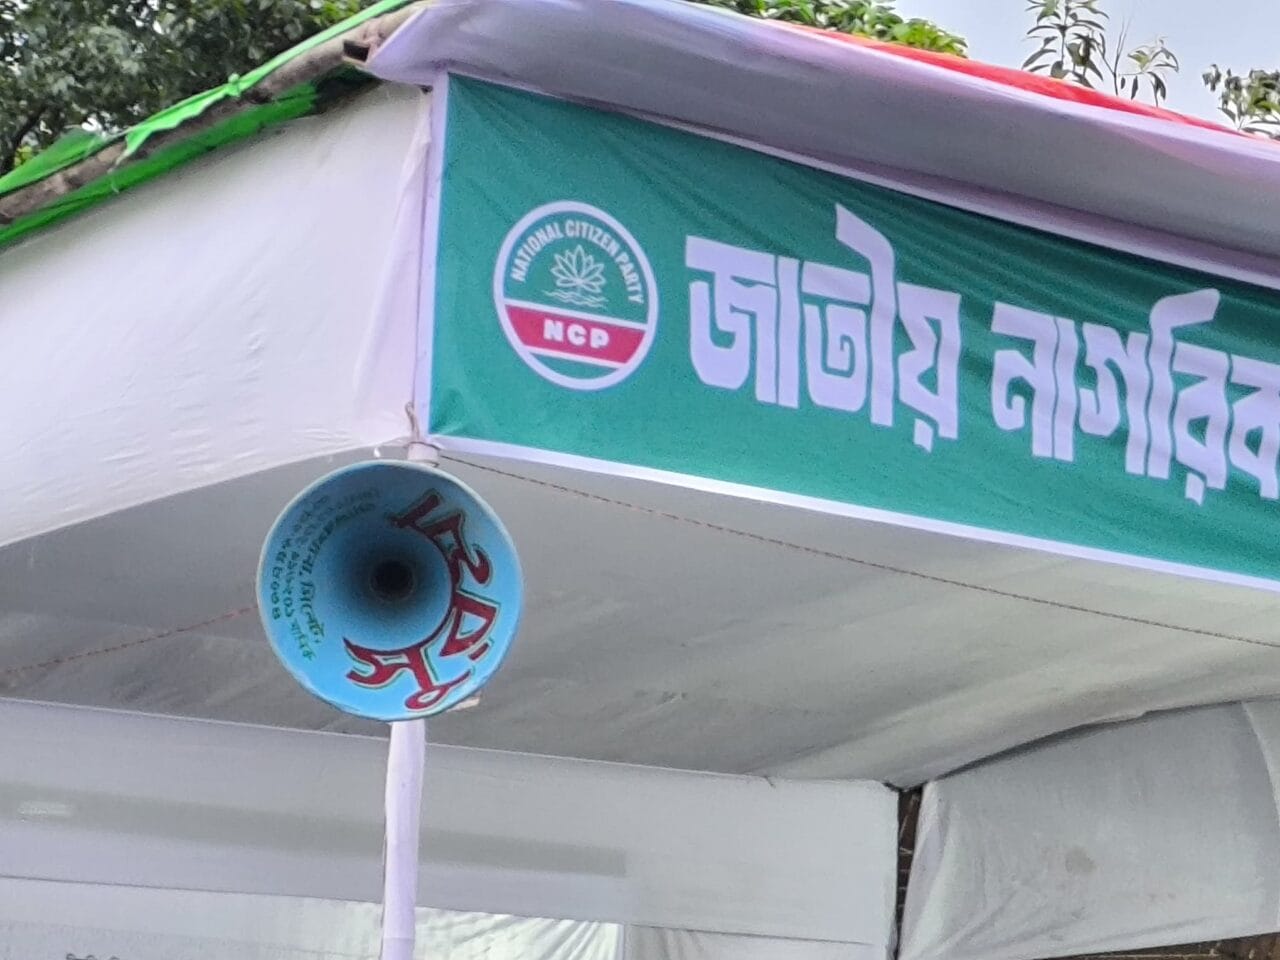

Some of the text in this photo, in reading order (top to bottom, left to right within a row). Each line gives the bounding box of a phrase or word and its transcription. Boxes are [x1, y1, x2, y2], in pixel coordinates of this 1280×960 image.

[510, 219, 645, 304] NATIONAL CITIZEN PARTY
[543, 319, 610, 348] NCP
[685, 203, 962, 453] জাতীয়
